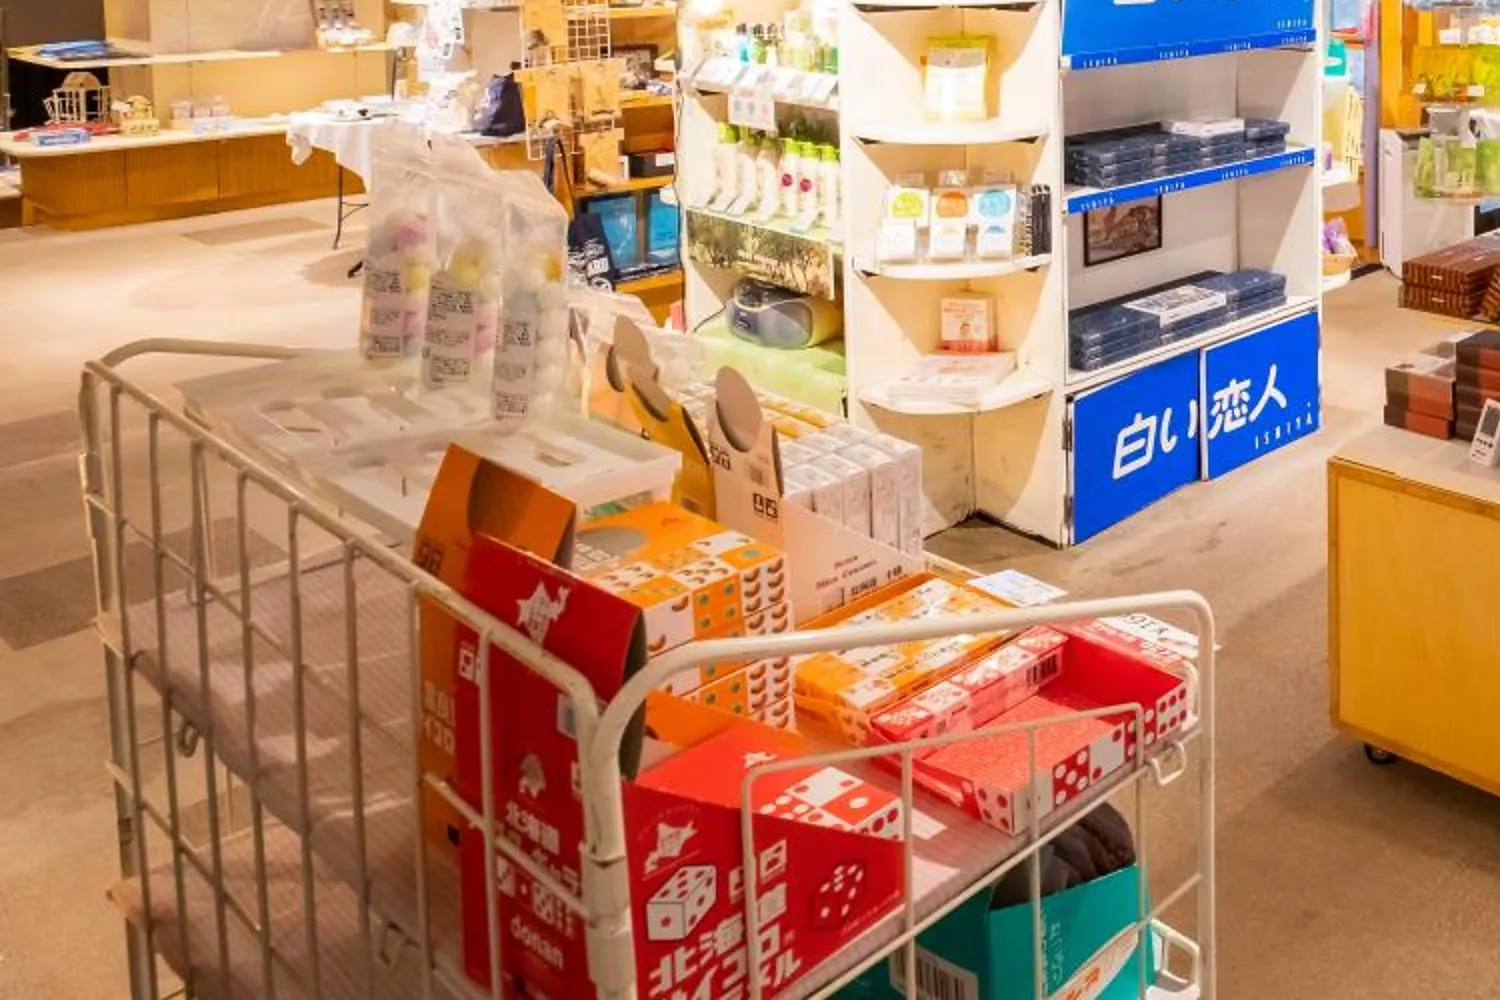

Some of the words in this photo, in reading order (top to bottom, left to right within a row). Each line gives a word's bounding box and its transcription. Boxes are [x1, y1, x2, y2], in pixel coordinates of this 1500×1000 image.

[1112, 364, 1288, 480] 白い恋人
[1255, 412, 1314, 450] ISHIYA
